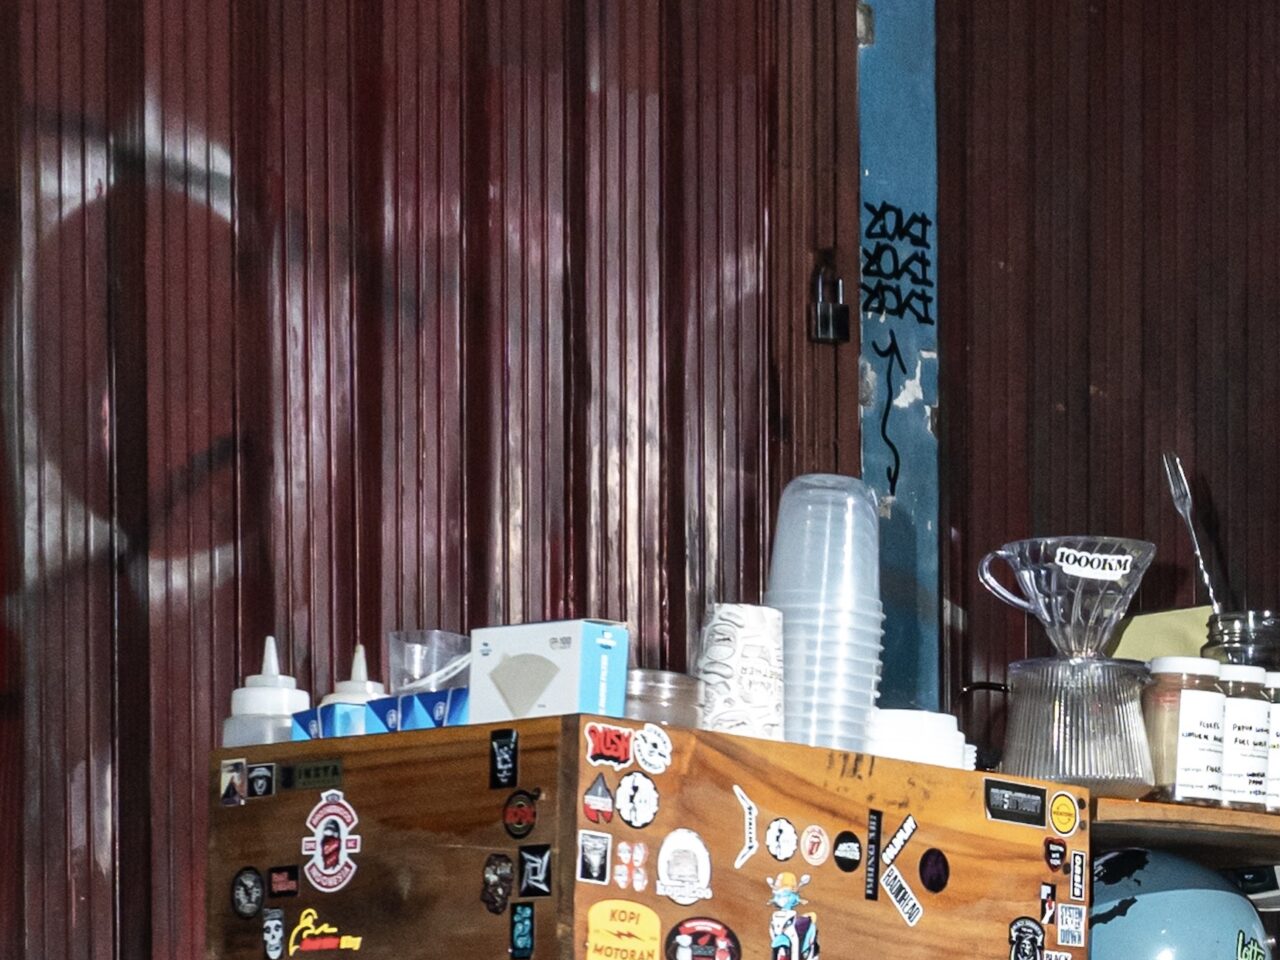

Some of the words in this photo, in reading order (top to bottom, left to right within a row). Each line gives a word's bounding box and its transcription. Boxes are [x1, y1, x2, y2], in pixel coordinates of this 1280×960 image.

[1058, 550, 1130, 572] 1000KM
[609, 909, 640, 925] KOPI
[592, 943, 655, 960] MOTORAN
